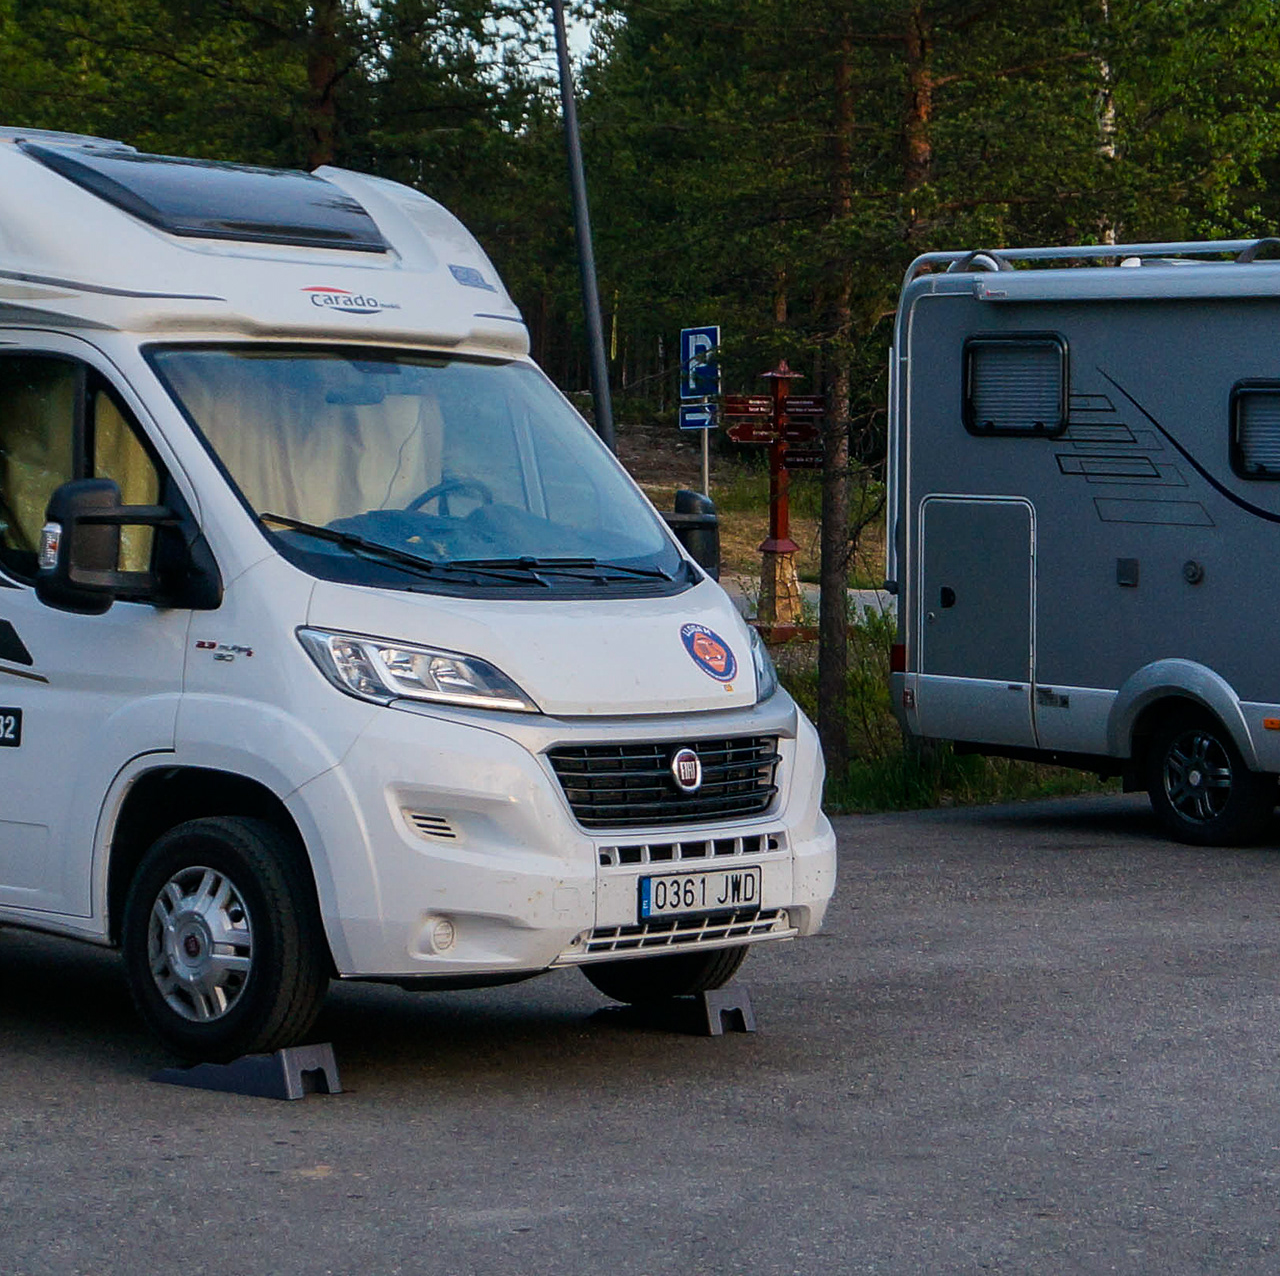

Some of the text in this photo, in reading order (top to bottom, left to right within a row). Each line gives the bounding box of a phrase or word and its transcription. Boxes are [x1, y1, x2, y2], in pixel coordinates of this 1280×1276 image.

[688, 334, 713, 389] P
[680, 761, 696, 780] FIAT
[655, 873, 756, 910] 0361 JWD
